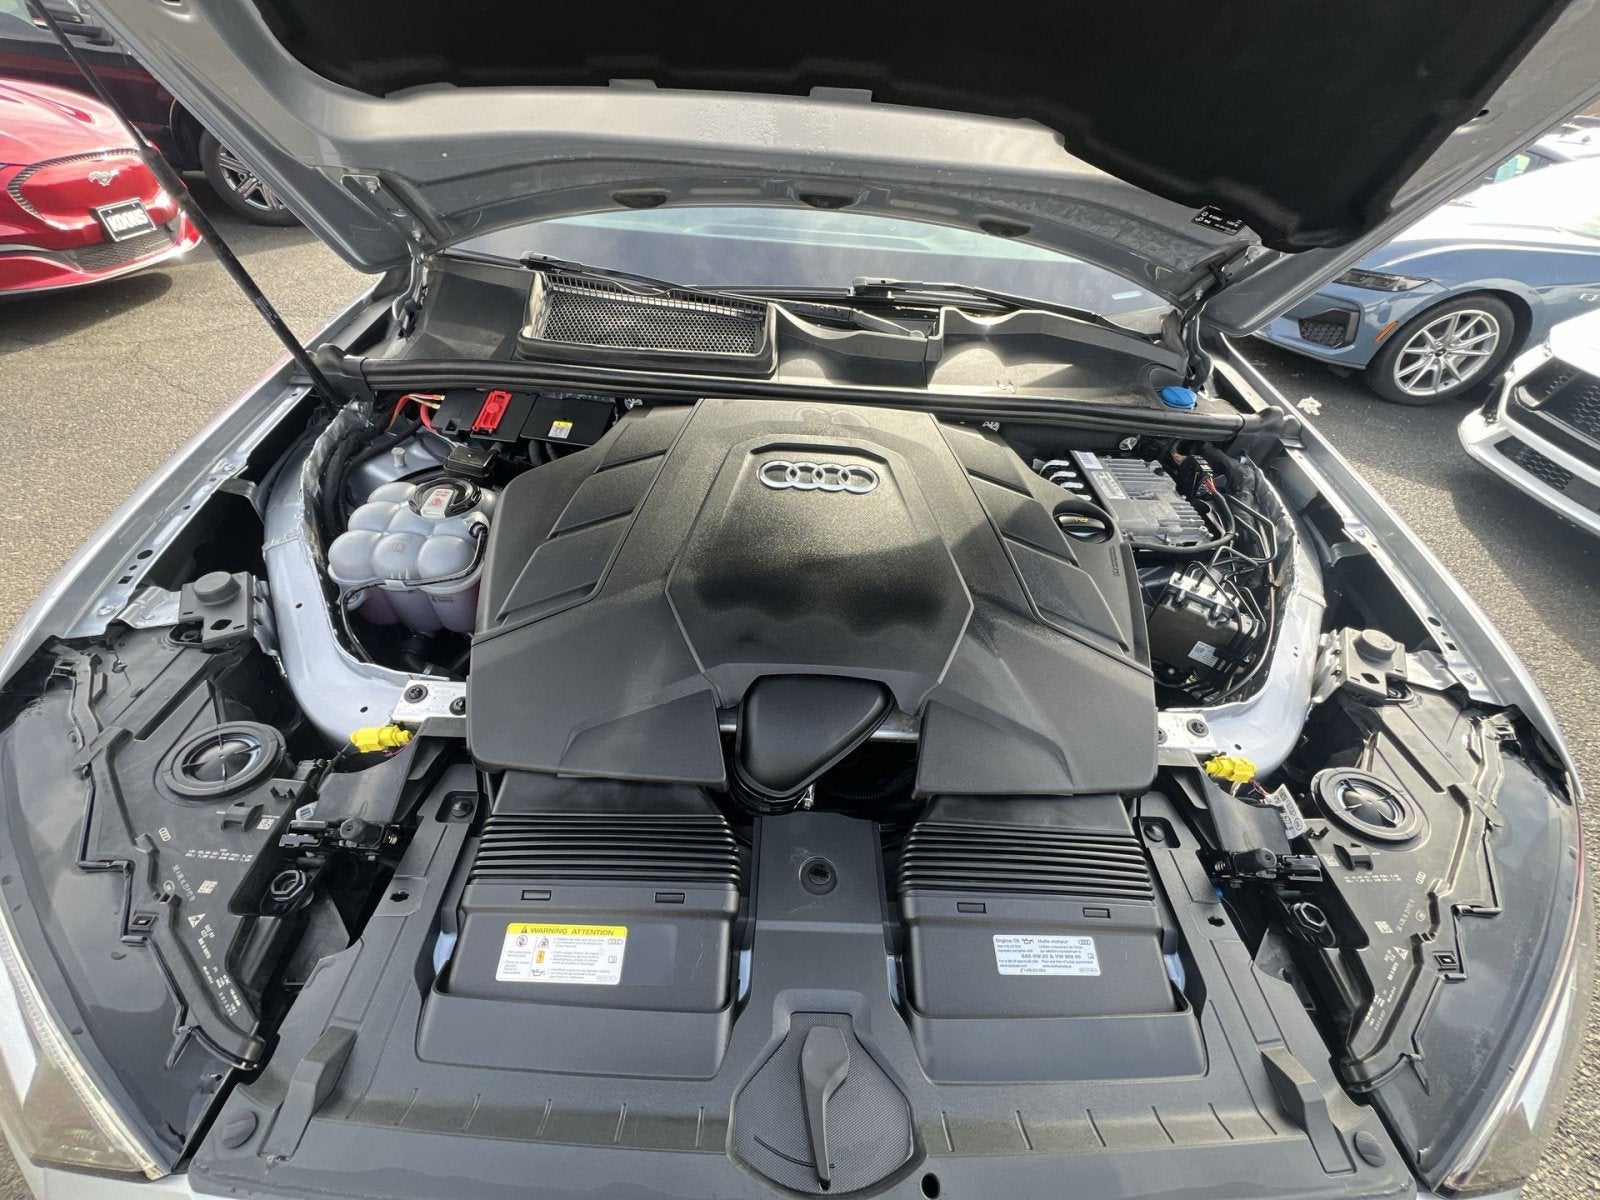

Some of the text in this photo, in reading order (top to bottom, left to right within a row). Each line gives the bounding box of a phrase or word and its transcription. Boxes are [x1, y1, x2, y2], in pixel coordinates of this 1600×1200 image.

[106, 208, 149, 232] KOONS
[530, 927, 614, 936] WARNING ATTENTION
